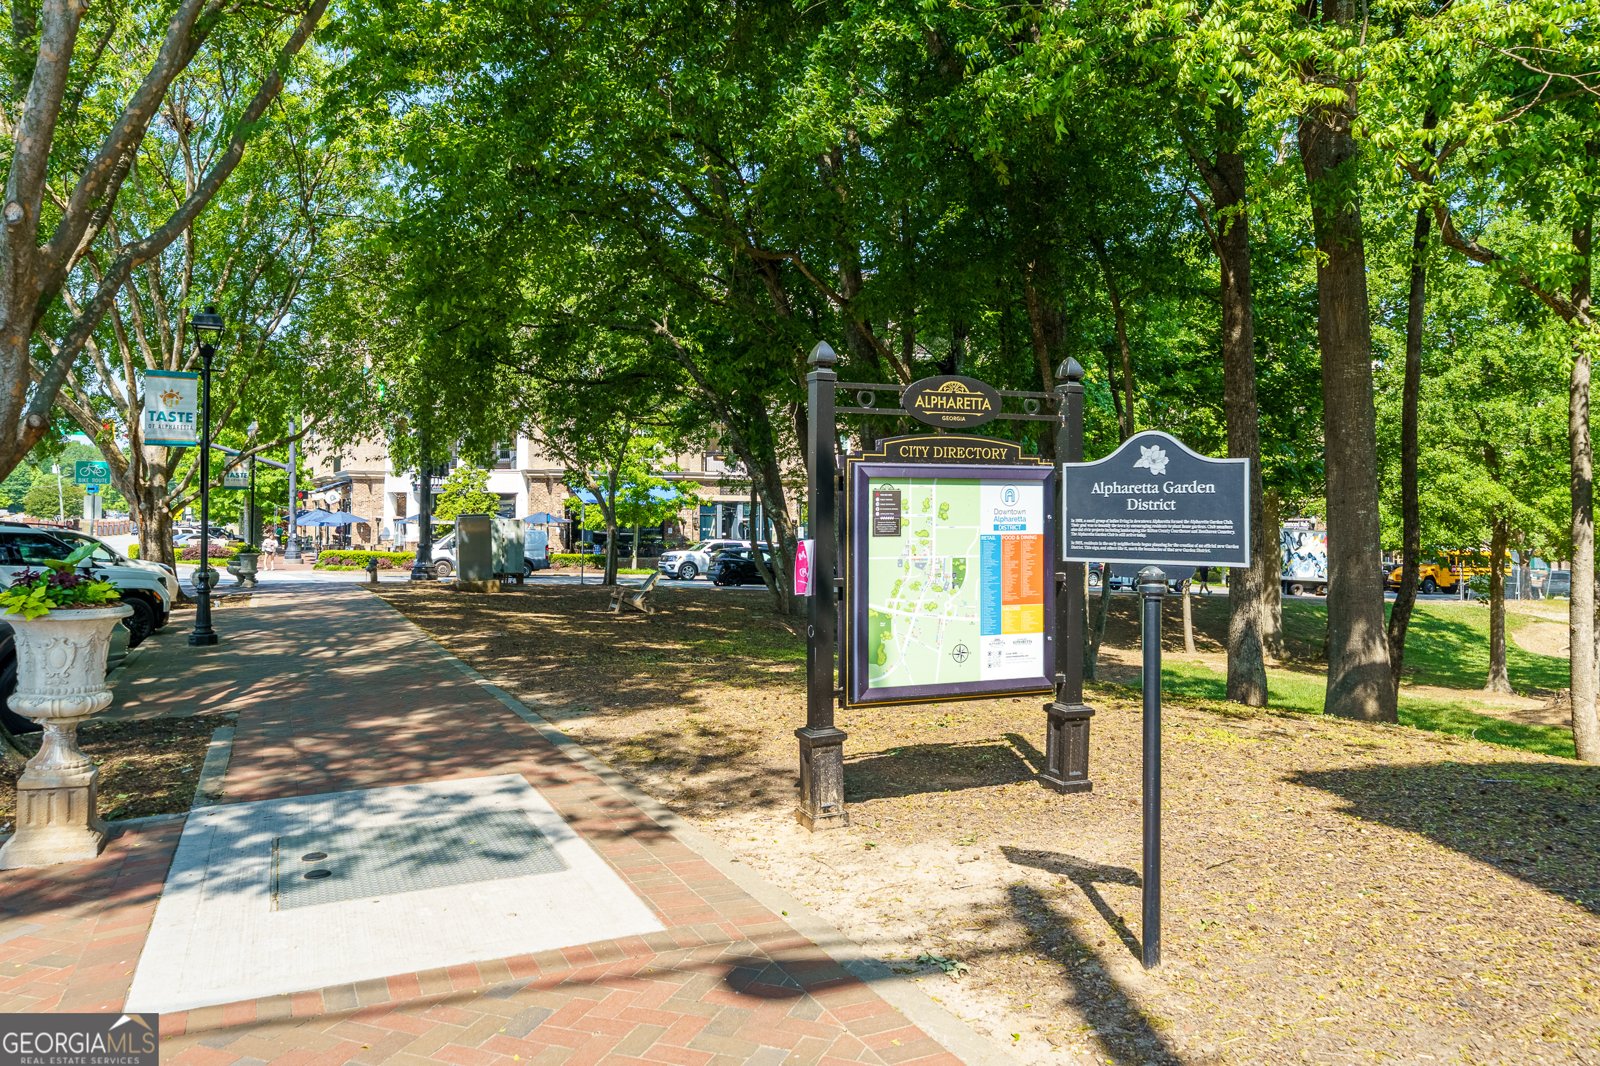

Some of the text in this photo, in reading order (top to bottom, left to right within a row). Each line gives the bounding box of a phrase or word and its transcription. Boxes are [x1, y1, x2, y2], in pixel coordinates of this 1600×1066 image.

[915, 394, 992, 410] ALPHARETTA
[148, 410, 193, 423] TASTE
[900, 445, 1008, 459] CITY DIRECTORY
[1091, 480, 1216, 497] Alpharetta Garden
[1127, 498, 1176, 511] District
